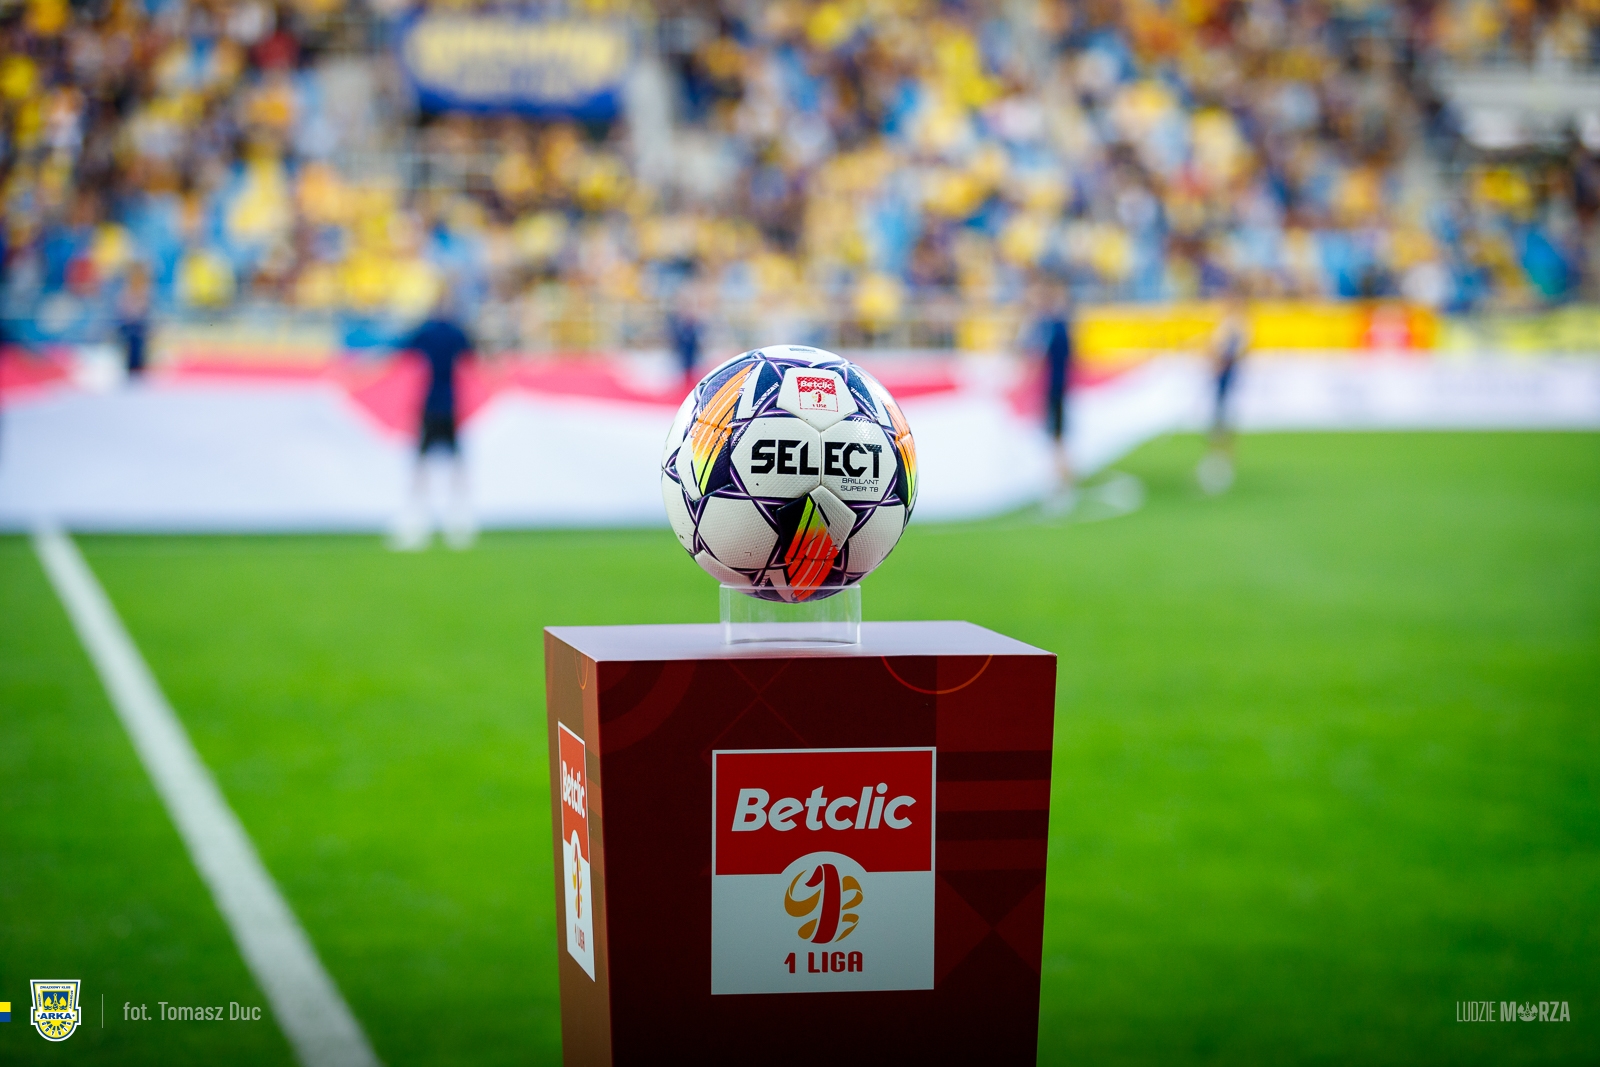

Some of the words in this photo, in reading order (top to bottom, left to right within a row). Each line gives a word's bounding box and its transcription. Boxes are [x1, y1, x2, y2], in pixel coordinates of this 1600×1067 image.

[800, 380, 833, 390] Betclic
[750, 439, 883, 479] SELECT
[562, 760, 586, 819] Betclic
[731, 782, 917, 832] Betclic
[784, 952, 796, 974] 1
[807, 951, 863, 974] LIGA
